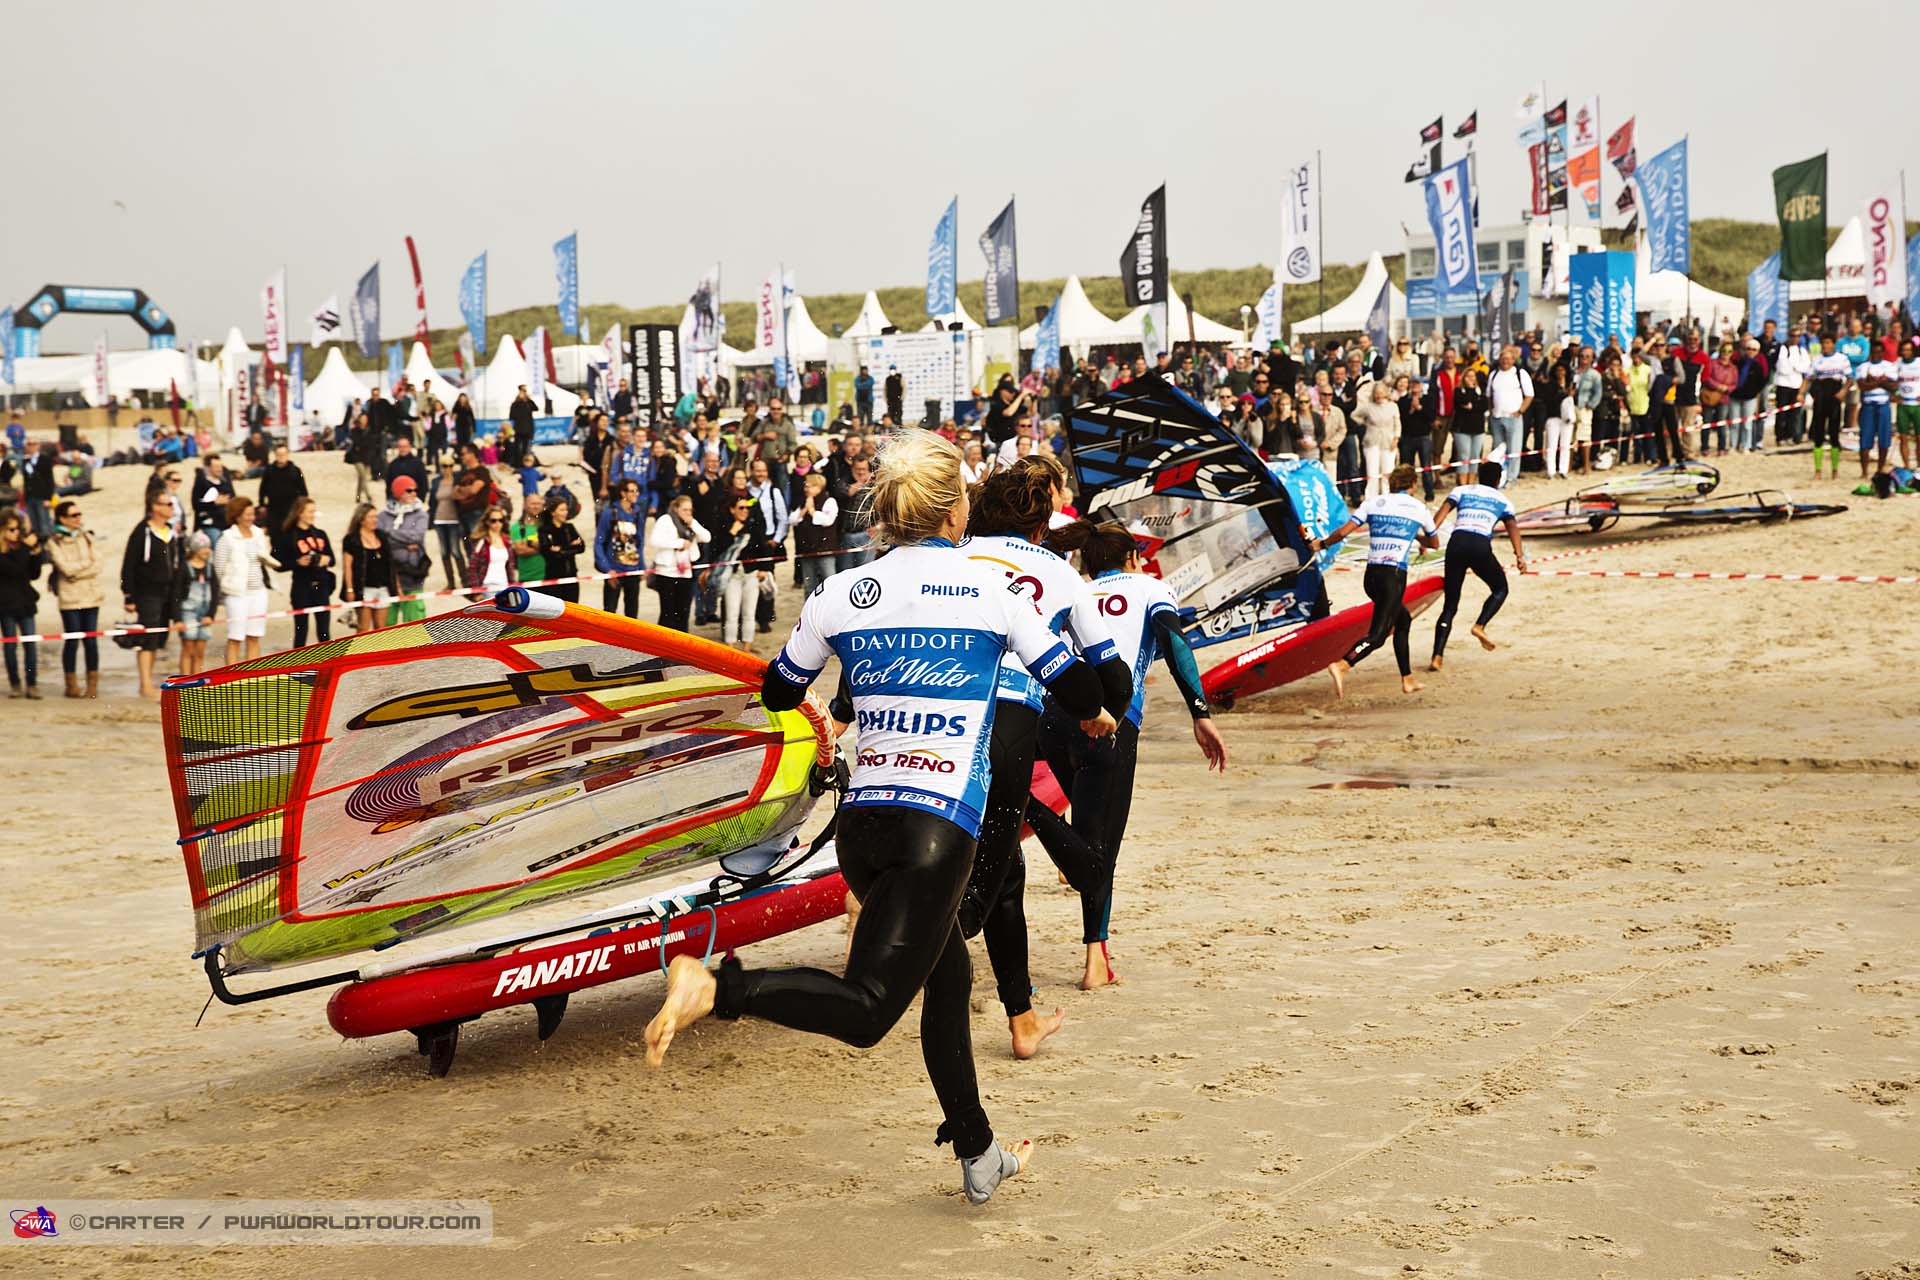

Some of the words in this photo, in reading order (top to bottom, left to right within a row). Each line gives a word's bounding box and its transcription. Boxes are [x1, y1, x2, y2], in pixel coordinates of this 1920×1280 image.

[635, 329, 649, 367] DAVID
[658, 330, 675, 367] DAVID
[637, 367, 650, 405] CAMP
[660, 367, 677, 404] CAMP
[921, 584, 980, 598] PHILIPS
[851, 633, 976, 652] DAVIDOFF
[1237, 641, 1277, 668] FANATIC
[777, 663, 795, 679] ran
[850, 656, 899, 686] Cool
[894, 657, 979, 689] Water
[1042, 660, 1059, 677] ran
[858, 709, 967, 738] PHILIPS
[439, 709, 724, 797] RENO
[894, 754, 956, 773] RENO
[860, 791, 880, 799] ran
[902, 793, 926, 803] ran
[322, 787, 580, 890] WIZARD
[623, 943, 636, 955] FLY
[637, 941, 651, 952] AIR
[492, 944, 617, 998] FANATIC
